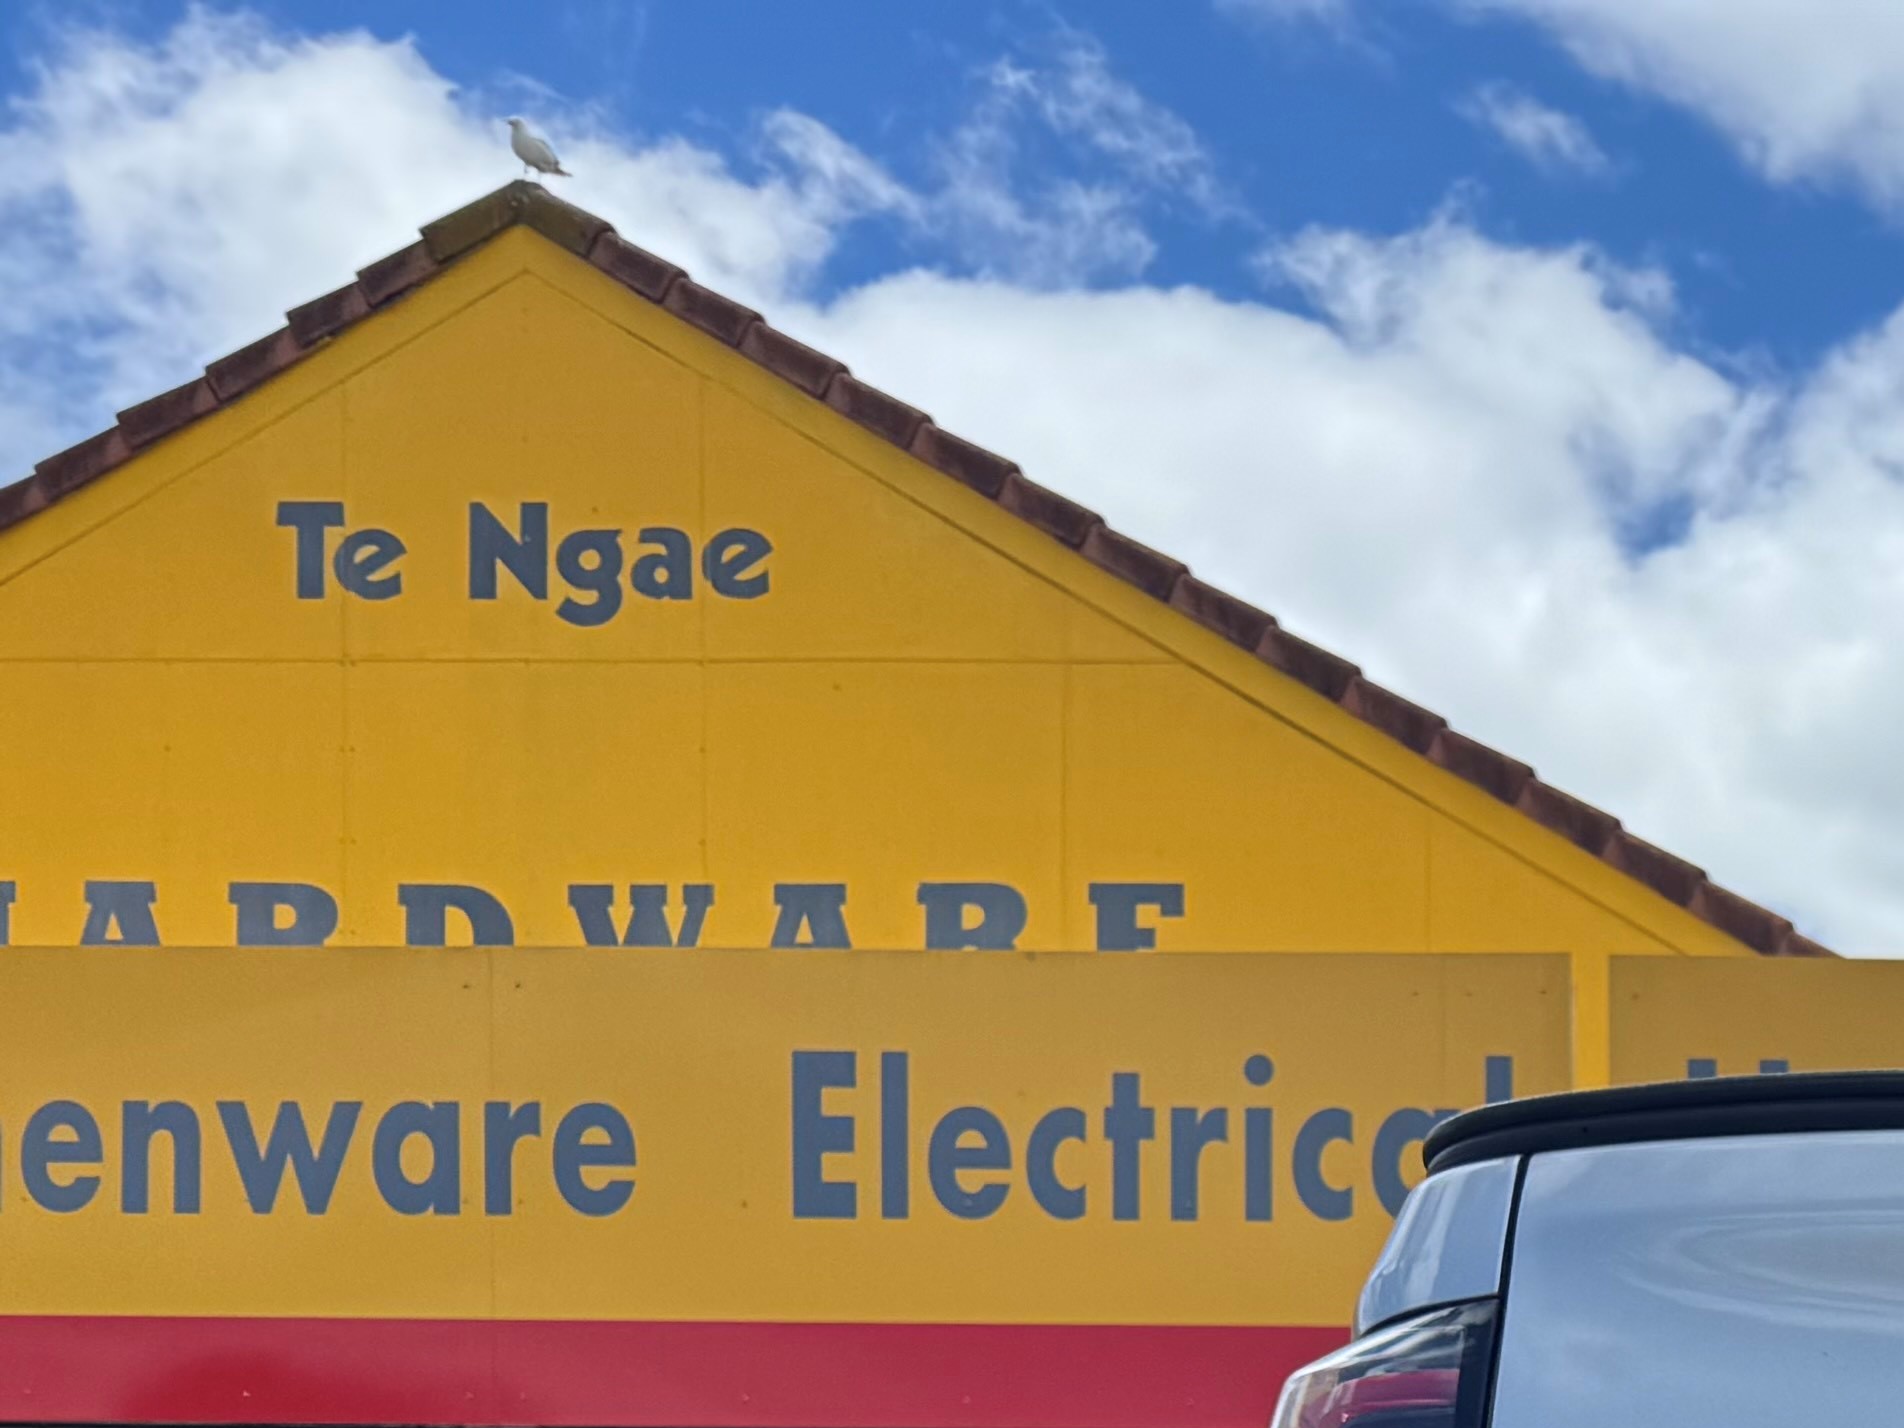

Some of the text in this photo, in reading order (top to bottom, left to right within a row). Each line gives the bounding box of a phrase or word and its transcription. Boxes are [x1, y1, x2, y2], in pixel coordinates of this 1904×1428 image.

[276, 501, 774, 627] Te Ngae
[0, 881, 1186, 952] ARDWARE
[0, 1098, 637, 1217] enware
